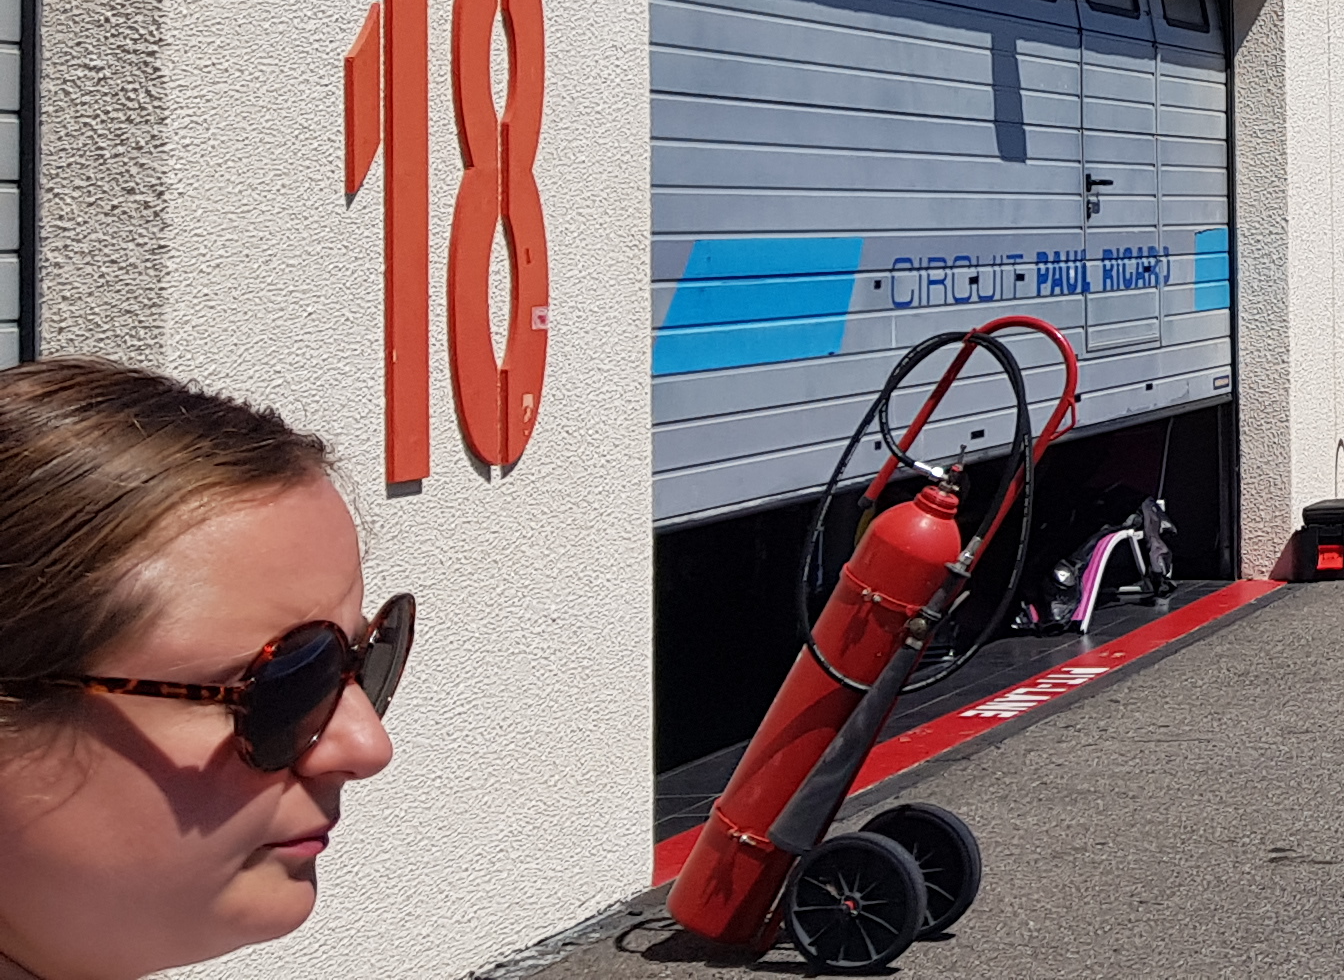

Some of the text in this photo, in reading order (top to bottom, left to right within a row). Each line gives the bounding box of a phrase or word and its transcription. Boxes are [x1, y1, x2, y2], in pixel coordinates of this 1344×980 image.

[891, 253, 1024, 308] CIRCUIT
[1036, 248, 1090, 296] PAUL
[958, 667, 1110, 718] PIT-LANE
